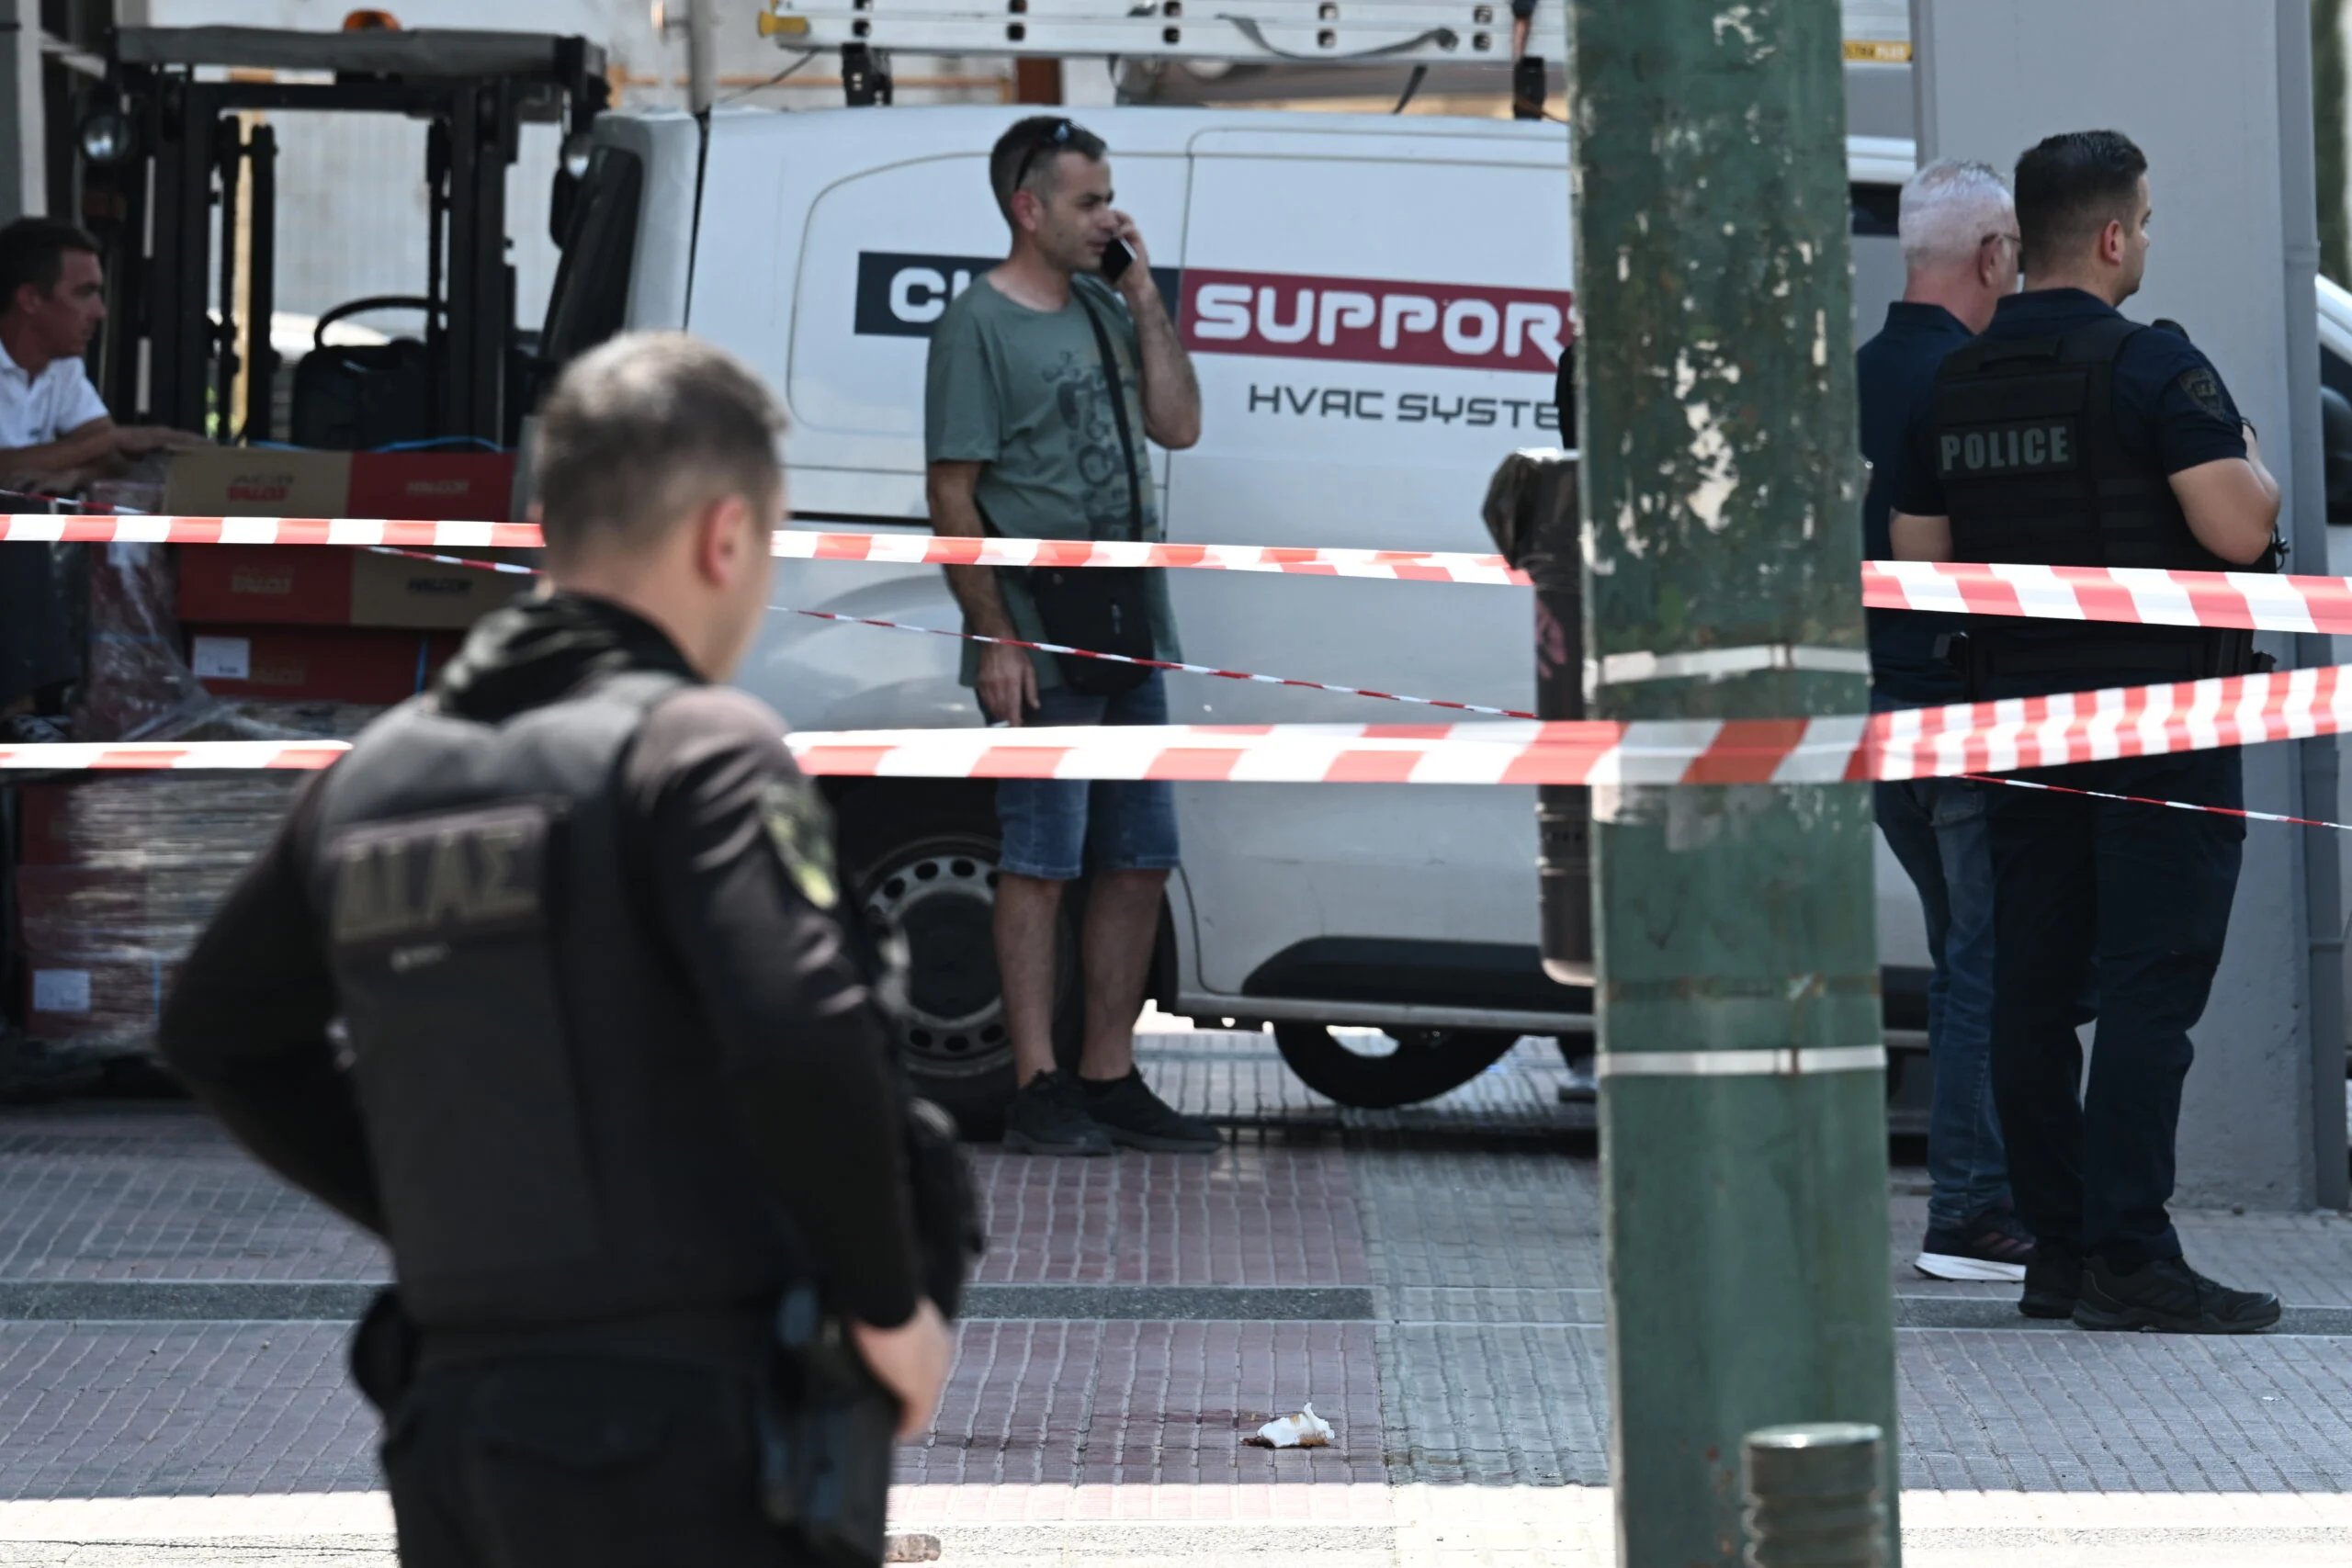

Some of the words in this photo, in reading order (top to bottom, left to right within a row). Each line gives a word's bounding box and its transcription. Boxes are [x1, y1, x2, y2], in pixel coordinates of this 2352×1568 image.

[1193, 283, 1578, 366] SUPPOR
[1248, 383, 1385, 421] HVAC
[1396, 392, 1562, 430] SYSTE
[1940, 425, 2068, 470] POLICE
